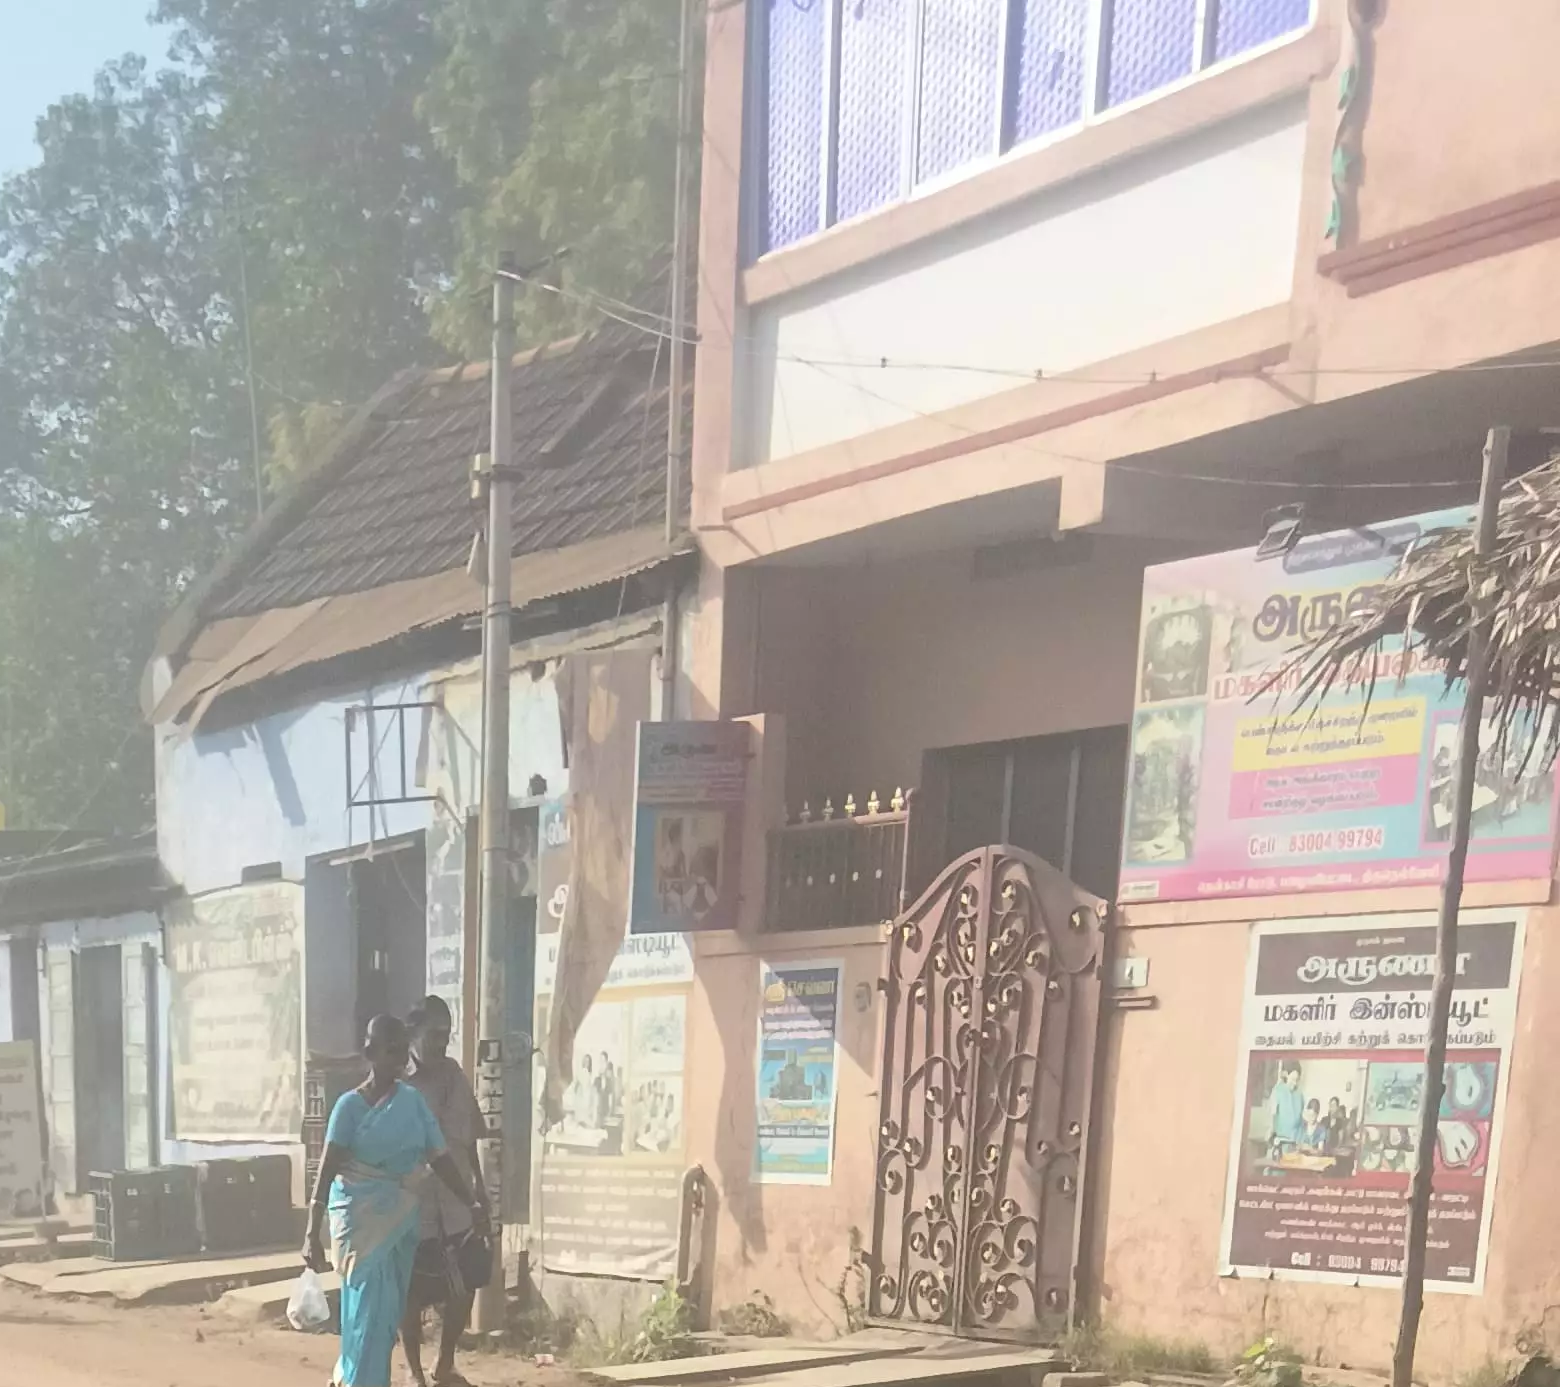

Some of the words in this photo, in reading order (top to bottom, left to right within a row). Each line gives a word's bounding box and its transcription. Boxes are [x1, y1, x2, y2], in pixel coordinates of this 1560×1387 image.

[1250, 836, 1276, 856] Cell
[1264, 994, 1337, 1022] மகளிர்
[1350, 992, 1490, 1027] இன்ஸ்யூட்
